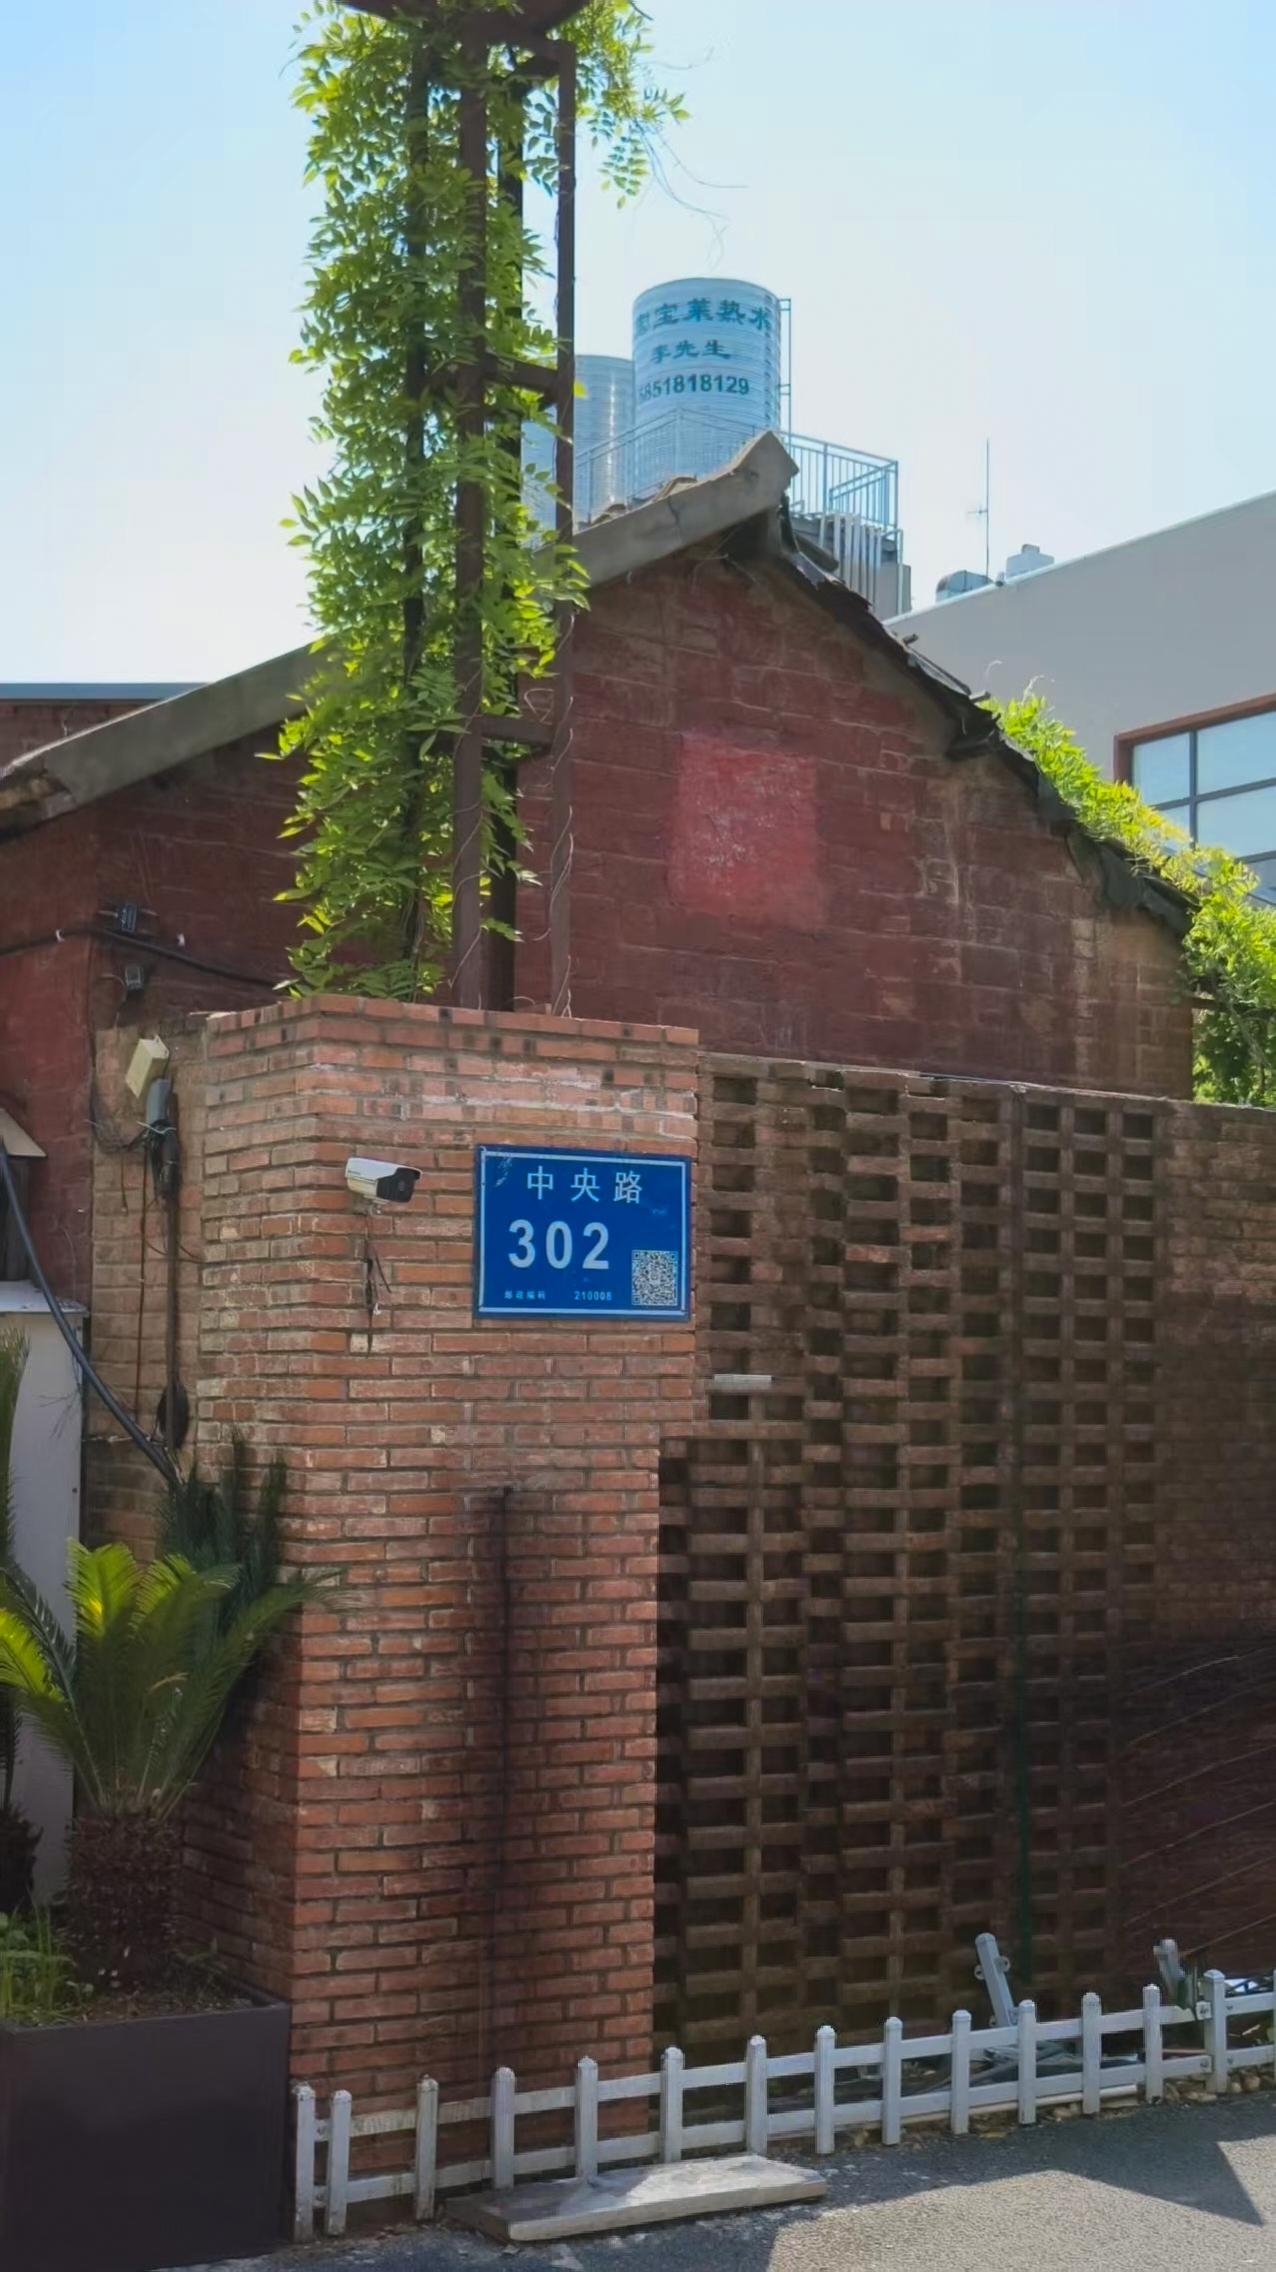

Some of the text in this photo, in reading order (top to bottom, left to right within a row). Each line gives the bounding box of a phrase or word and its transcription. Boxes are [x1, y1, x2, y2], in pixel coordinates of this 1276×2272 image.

[526, 1165, 643, 1204] 中央路
[508, 1219, 610, 1270] 302
